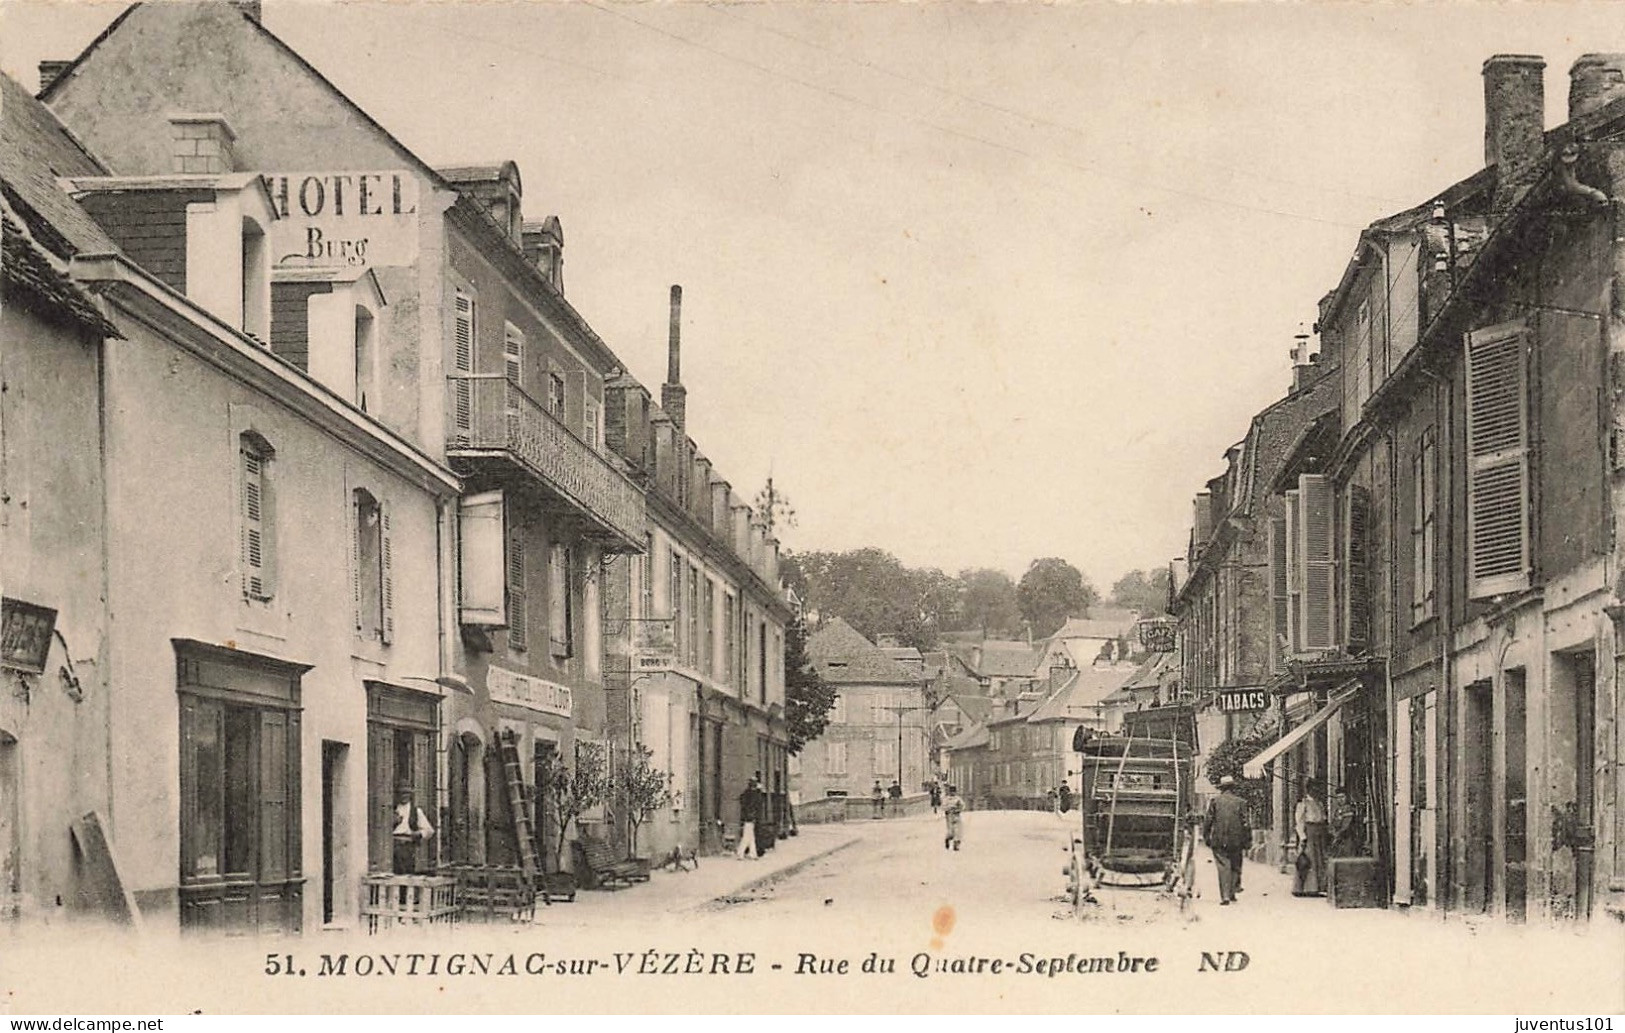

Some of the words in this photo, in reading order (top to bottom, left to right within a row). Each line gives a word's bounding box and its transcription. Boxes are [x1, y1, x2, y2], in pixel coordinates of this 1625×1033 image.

[266, 174, 416, 217] HOTEL
[305, 226, 369, 266] Burg
[1220, 692, 1265, 712] TABACS
